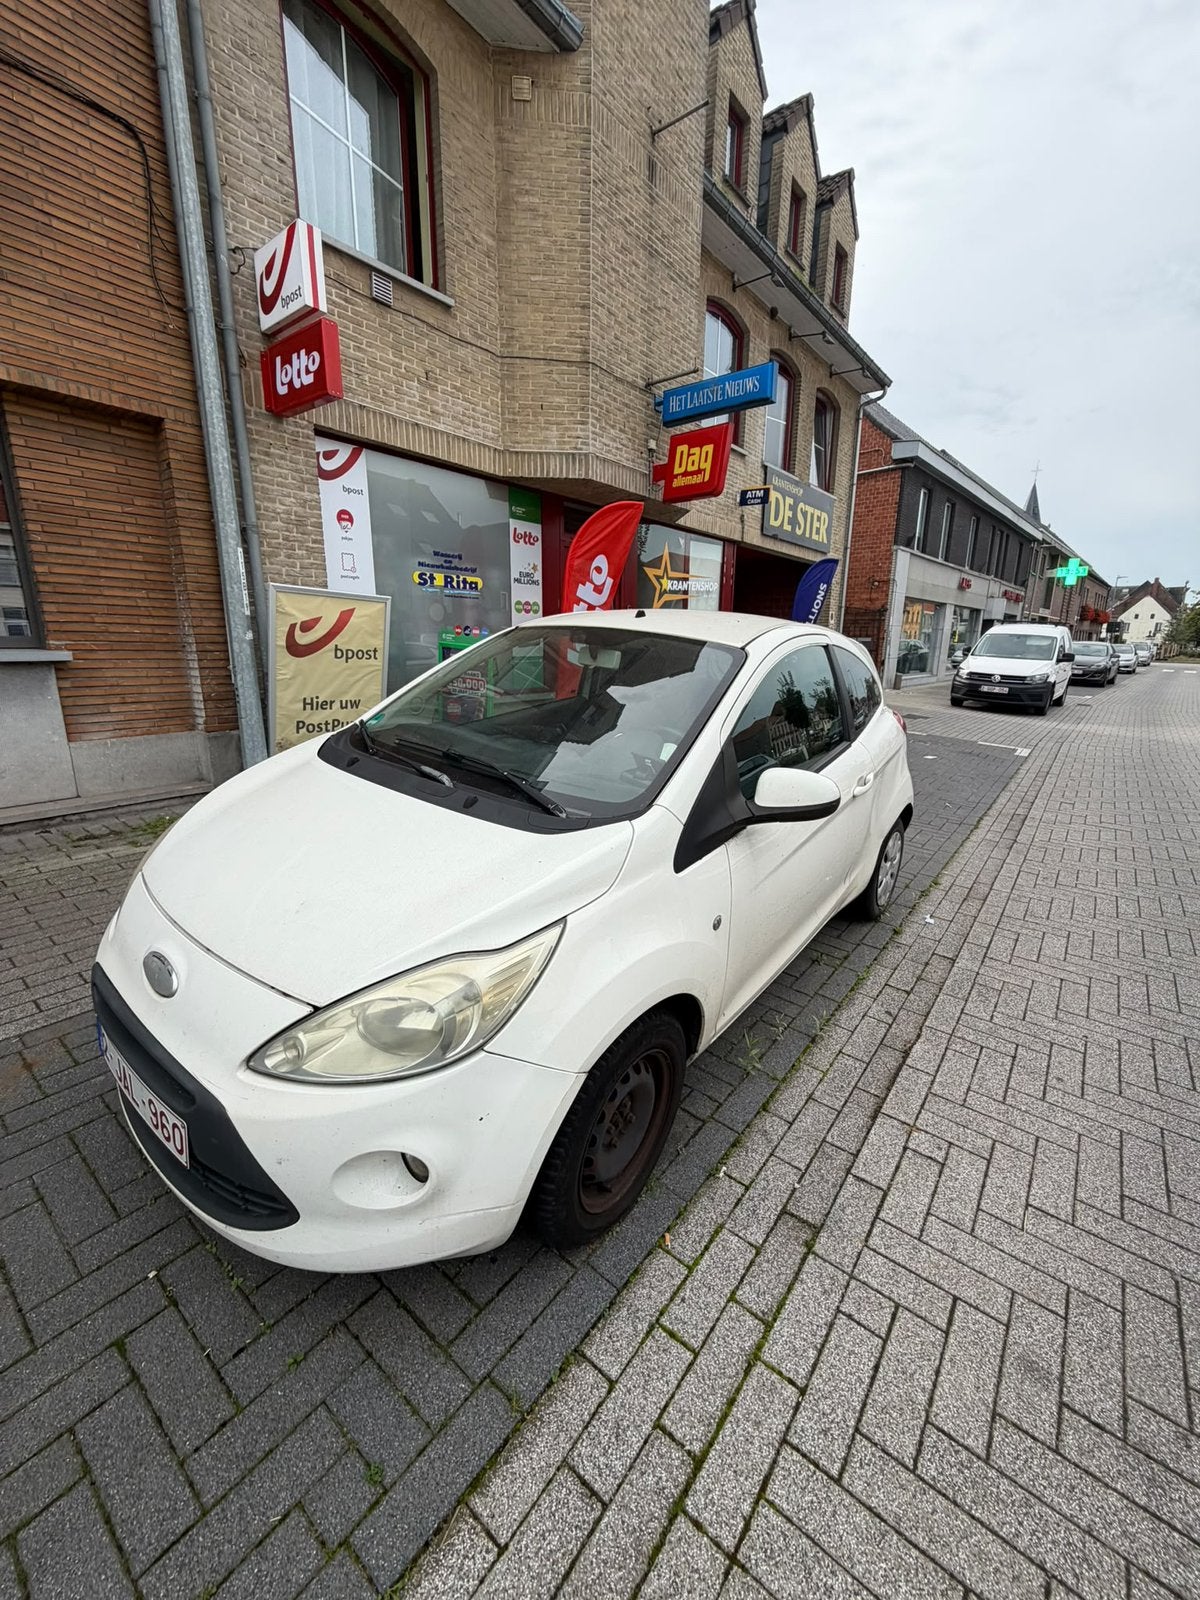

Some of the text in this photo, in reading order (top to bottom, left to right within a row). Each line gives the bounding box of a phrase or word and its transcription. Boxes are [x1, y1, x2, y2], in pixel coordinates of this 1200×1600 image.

[281, 285, 303, 309] bpost
[669, 375, 760, 413] HET LAATSTE NIEUWS
[672, 471, 705, 488] allemaal
[342, 484, 364, 496] bpost
[745, 489, 764, 499] ATM
[770, 490, 829, 545] DE STER
[417, 572, 436, 587] St
[443, 574, 479, 591] Rita
[513, 577, 540, 588] MILLIONS
[519, 571, 535, 580] EURO
[667, 580, 719, 592] KRANTENSHOP
[334, 644, 379, 663] bpost
[302, 695, 361, 712] Hier uw
[295, 718, 355, 735] PostPu
